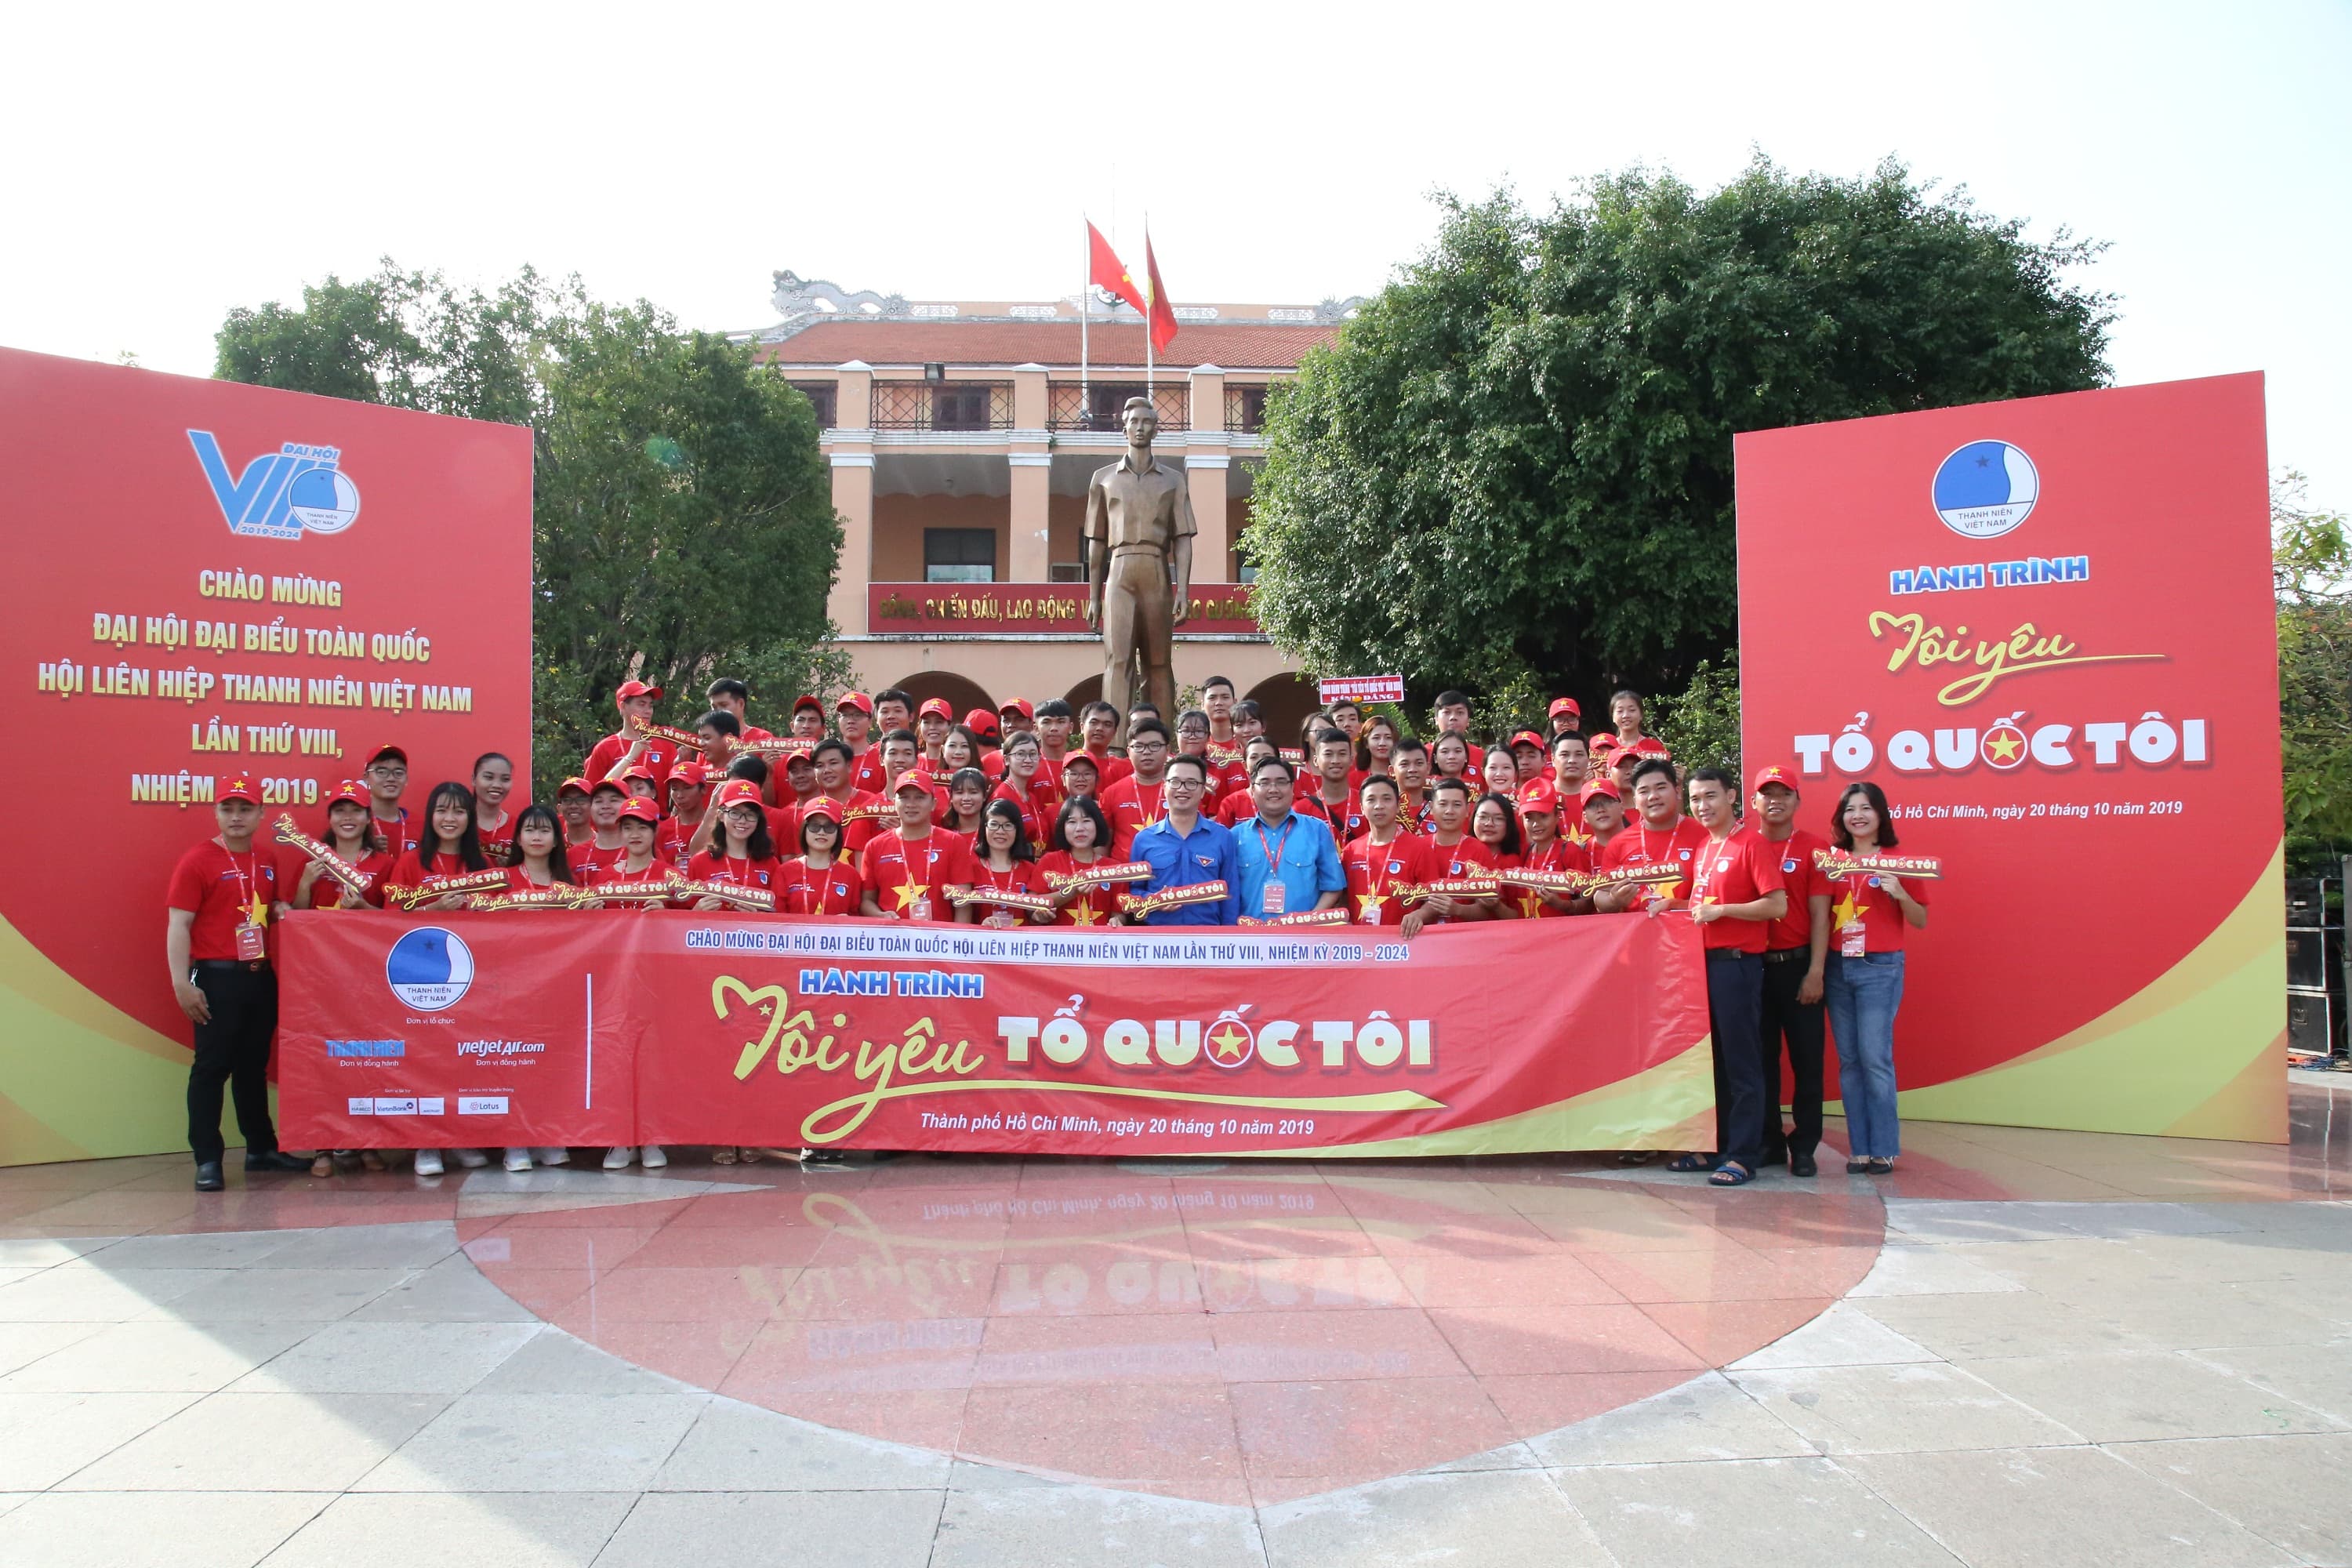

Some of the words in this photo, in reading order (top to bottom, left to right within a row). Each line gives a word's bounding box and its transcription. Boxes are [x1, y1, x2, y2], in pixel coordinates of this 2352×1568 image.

[283, 444, 309, 457] ĐẠI
[311, 448, 339, 461] HỘI
[1958, 510, 1990, 520] THANH
[1991, 507, 2013, 519] NIÊN
[1964, 519, 1985, 530] VIỆT
[1987, 518, 2007, 528] NAM
[241, 526, 300, 539] 2019-2024
[1890, 564, 1983, 595] HÀNH
[1989, 555, 2089, 588] TRÌNH
[200, 568, 263, 600] CHÀO
[272, 573, 341, 606] MỪNG
[926, 593, 967, 619] CHIẾN
[971, 593, 1003, 622] ĐẤU,
[1007, 599, 1033, 619] LAO
[1037, 594, 1076, 624] ĐỘNG
[93, 613, 136, 647] ĐẠI
[146, 613, 187, 651] HỘI
[195, 621, 236, 654] ĐẠI
[245, 616, 297, 652] BIỂU
[305, 626, 364, 657] TOÀN
[372, 628, 429, 661] QUỐC
[39, 659, 83, 697] HỘI
[93, 662, 149, 695] LIÊN
[158, 666, 214, 703] HIỆP
[223, 674, 300, 702] THANH
[308, 675, 362, 706] NIÊN
[370, 678, 416, 713] VIỆT
[423, 685, 471, 711] NAM
[192, 716, 238, 751] LẦN
[247, 722, 294, 753] THỨ
[299, 728, 342, 757] VIII,
[1795, 711, 1874, 774] TỔ
[1887, 711, 2074, 771] QUỐC
[2085, 711, 2205, 765] TÔI
[132, 770, 213, 808] NHIỆM
[261, 778, 317, 804] 2019
[1888, 801, 1901, 819] hố
[1905, 804, 1922, 818] Hồ
[1928, 806, 1950, 818] Chí
[1953, 805, 1987, 818] Minh,
[1993, 804, 2026, 819] ngày
[2030, 804, 2045, 815] 20
[2050, 803, 2089, 818] tháng
[2094, 803, 2109, 815] 10
[2114, 802, 2143, 815] năm
[2149, 801, 2182, 814] 2019
[1610, 866, 1624, 880] TỔ
[1659, 862, 1679, 873] TÔI
[1861, 853, 1878, 867] TỔ
[1916, 859, 1936, 870] TÔI
[433, 877, 447, 890] TỔ
[485, 870, 504, 880] TÔI
[708, 880, 722, 891] TỔ
[753, 889, 771, 902] TÔI
[1160, 886, 1174, 901] TỔ
[1206, 881, 1225, 893] TÔI
[1431, 880, 1445, 891] TỔ
[1477, 880, 1497, 889] TÔI
[687, 930, 720, 948] CHÀO
[725, 931, 764, 949] MỪNG
[768, 934, 789, 953] ĐẠI
[793, 932, 815, 953] HỘI
[820, 936, 841, 954] ĐẠI
[846, 931, 874, 953] BIỂU
[879, 934, 911, 953] TOÀN
[915, 935, 949, 954] QUỐC
[953, 936, 974, 957] HỘI
[979, 936, 1005, 956] LIÊN
[1010, 938, 1039, 959] HIỆP
[1043, 943, 1083, 957] THANH
[1089, 938, 1118, 959] NIÊN
[1122, 938, 1147, 964] VIỆT
[1152, 944, 1180, 960] NAM
[1184, 938, 1207, 960] LẦN
[1210, 942, 1236, 960] THỨ
[1239, 945, 1263, 963] VIII,
[1268, 942, 1310, 965] NHIỆM
[1313, 941, 1330, 960] KỲ
[1332, 945, 1361, 960] 2019
[1376, 945, 1409, 961] 2024
[799, 967, 891, 996] HÀNH
[896, 971, 985, 1000] TRÌNH
[412, 995, 429, 1004] VIỆT
[997, 993, 1088, 1065] TỔ
[1103, 1004, 1301, 1069] QUỐC
[1312, 1010, 1431, 1067] TÔI
[364, 1059, 380, 1068] đồng
[922, 1113, 967, 1128] Thành
[971, 1112, 1000, 1132] phố
[1006, 1112, 1026, 1130] Hồ
[1032, 1116, 1058, 1131] Chí
[1062, 1116, 1101, 1134] Minh,
[1107, 1118, 1145, 1136] ngày
[1149, 1119, 1167, 1133] 20
[1171, 1119, 1214, 1137] tháng
[1220, 1120, 1236, 1134] 10
[1241, 1120, 1273, 1134] năm
[1279, 1120, 1313, 1134] 2019
